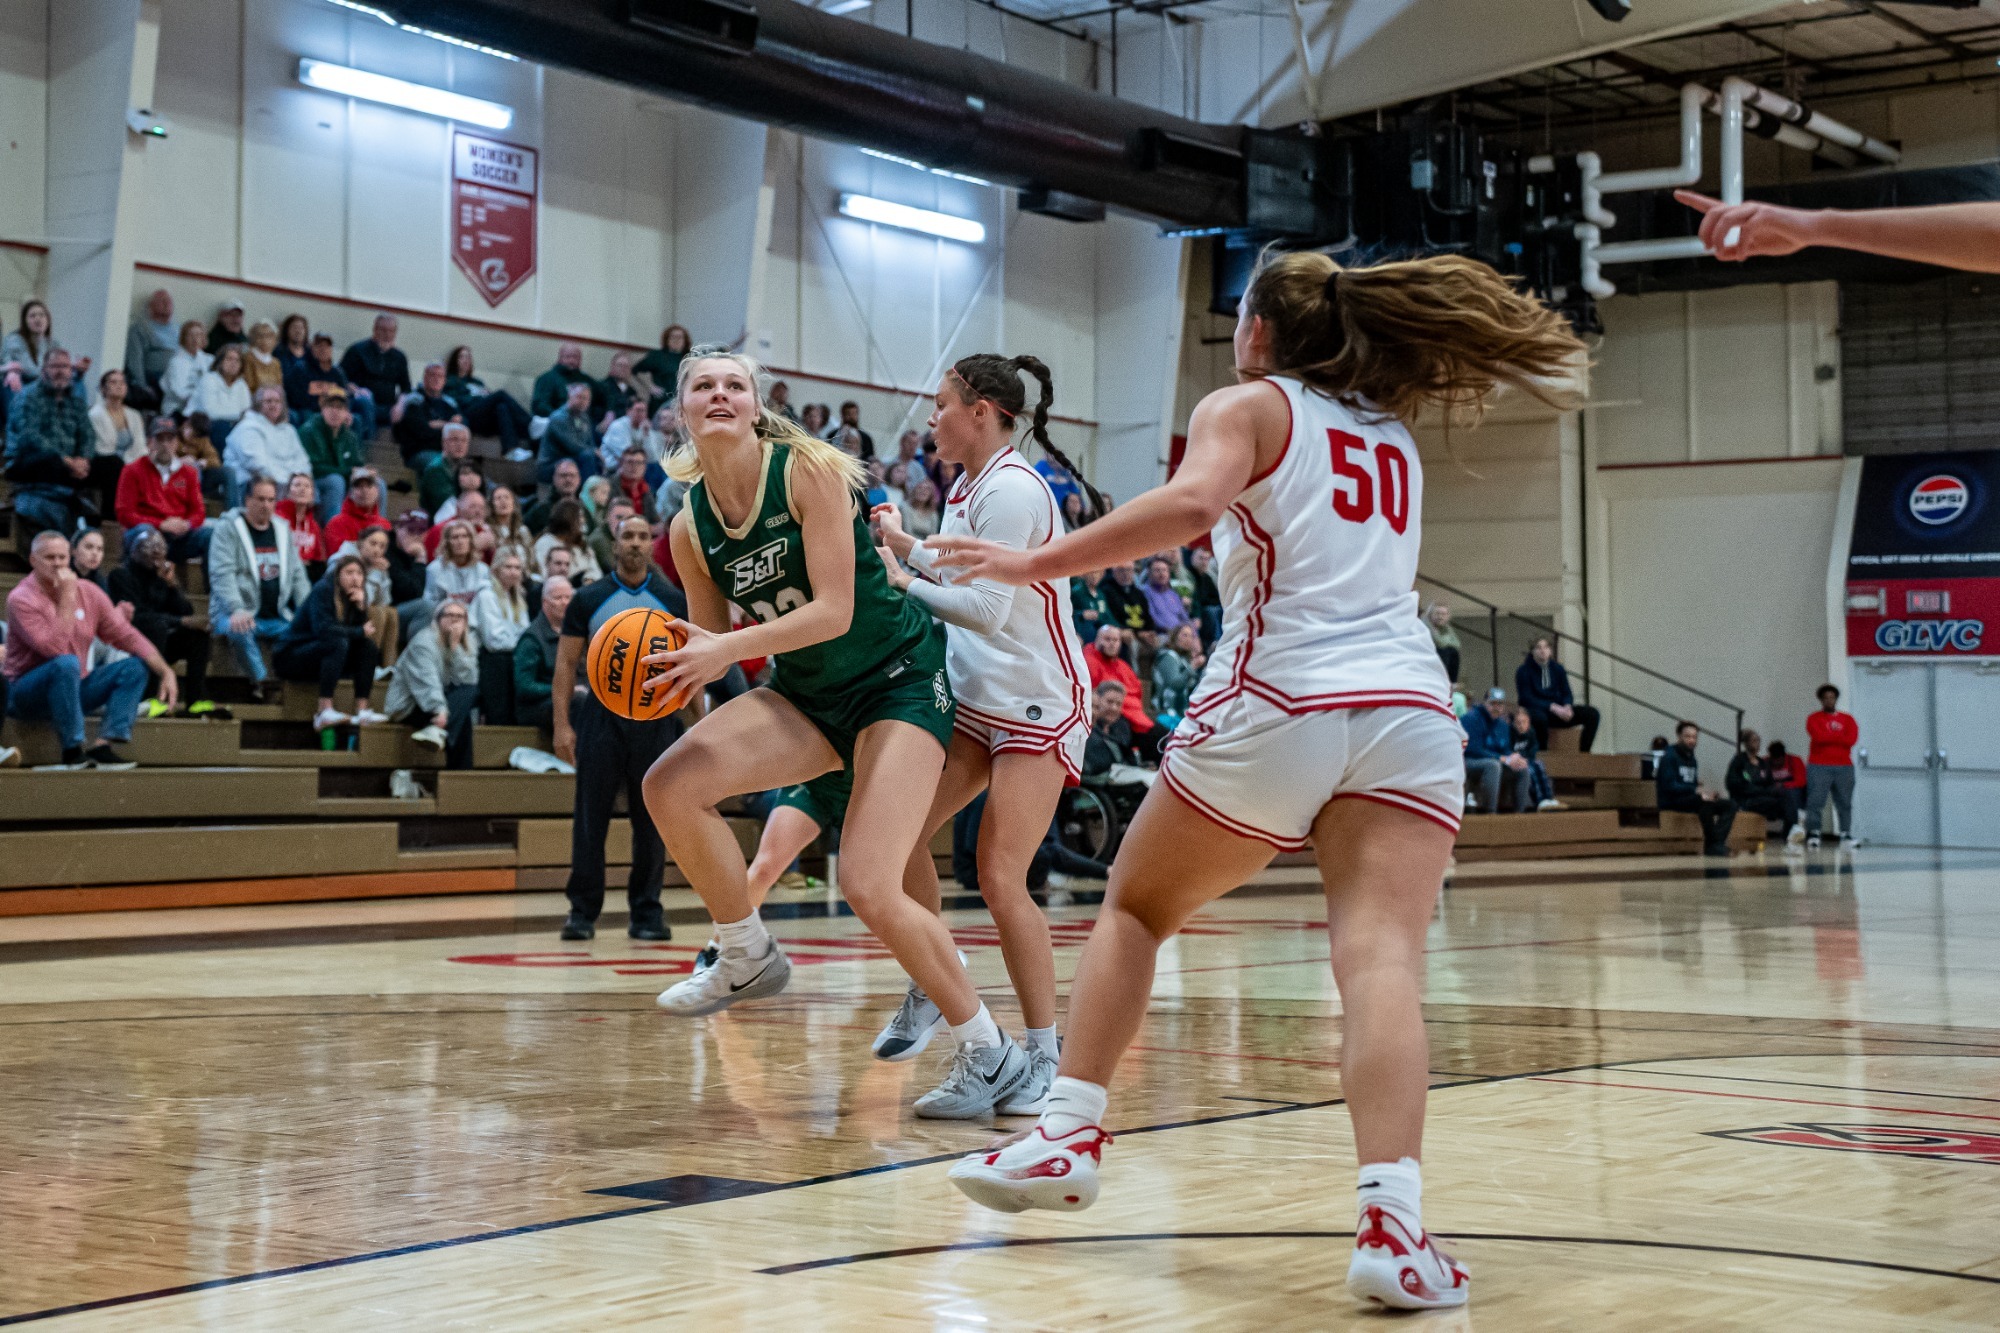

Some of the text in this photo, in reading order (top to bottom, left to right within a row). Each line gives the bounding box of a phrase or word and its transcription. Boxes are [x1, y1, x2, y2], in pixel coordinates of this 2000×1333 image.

[470, 145, 523, 168] WOMEN'S
[473, 162, 518, 184] SOCCER
[1326, 427, 1409, 536] 50
[1914, 494, 1963, 504] PEPSI
[733, 542, 784, 593] S&T
[1876, 620, 1983, 651] GLVC
[608, 638, 631, 694] NCAA
[639, 636, 668, 707] Wlon
